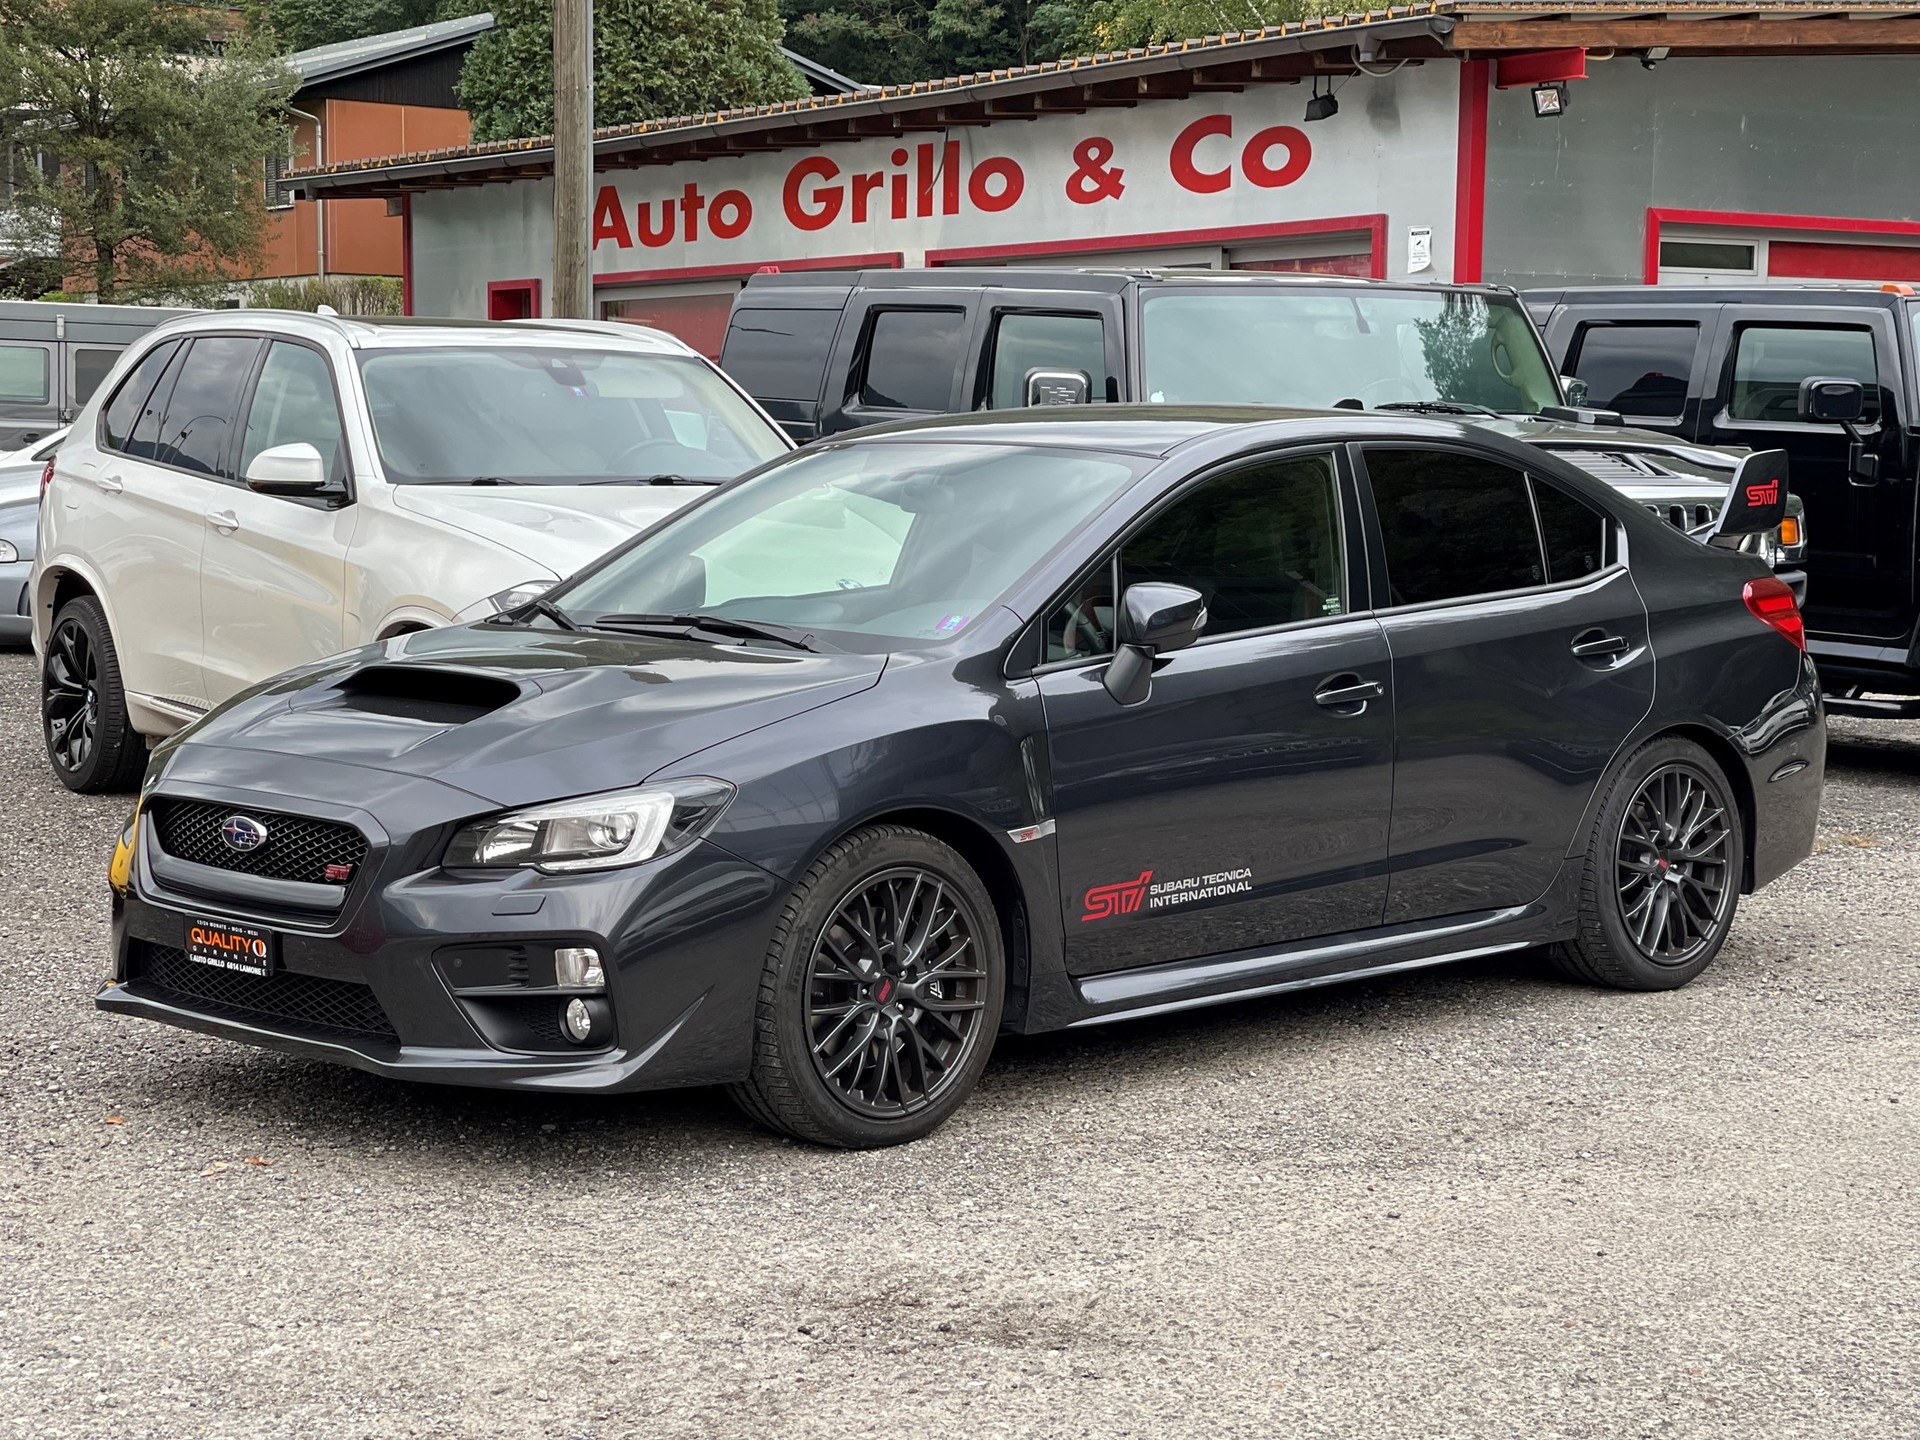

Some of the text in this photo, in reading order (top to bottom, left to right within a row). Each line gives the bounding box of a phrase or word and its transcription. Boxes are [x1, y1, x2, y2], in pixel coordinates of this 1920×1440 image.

[592, 114, 1312, 250] Auto Grillo & Co
[1149, 867, 1252, 895] SUBARU TECNICA
[1149, 880, 1253, 909] INTERNATIONAL
[191, 927, 251, 953] QUALITY
[192, 945, 267, 966] GARANTIE
[193, 954, 207, 964] AUTO
[207, 957, 225, 968] GRILLO
[239, 964, 262, 976] LAMONE
